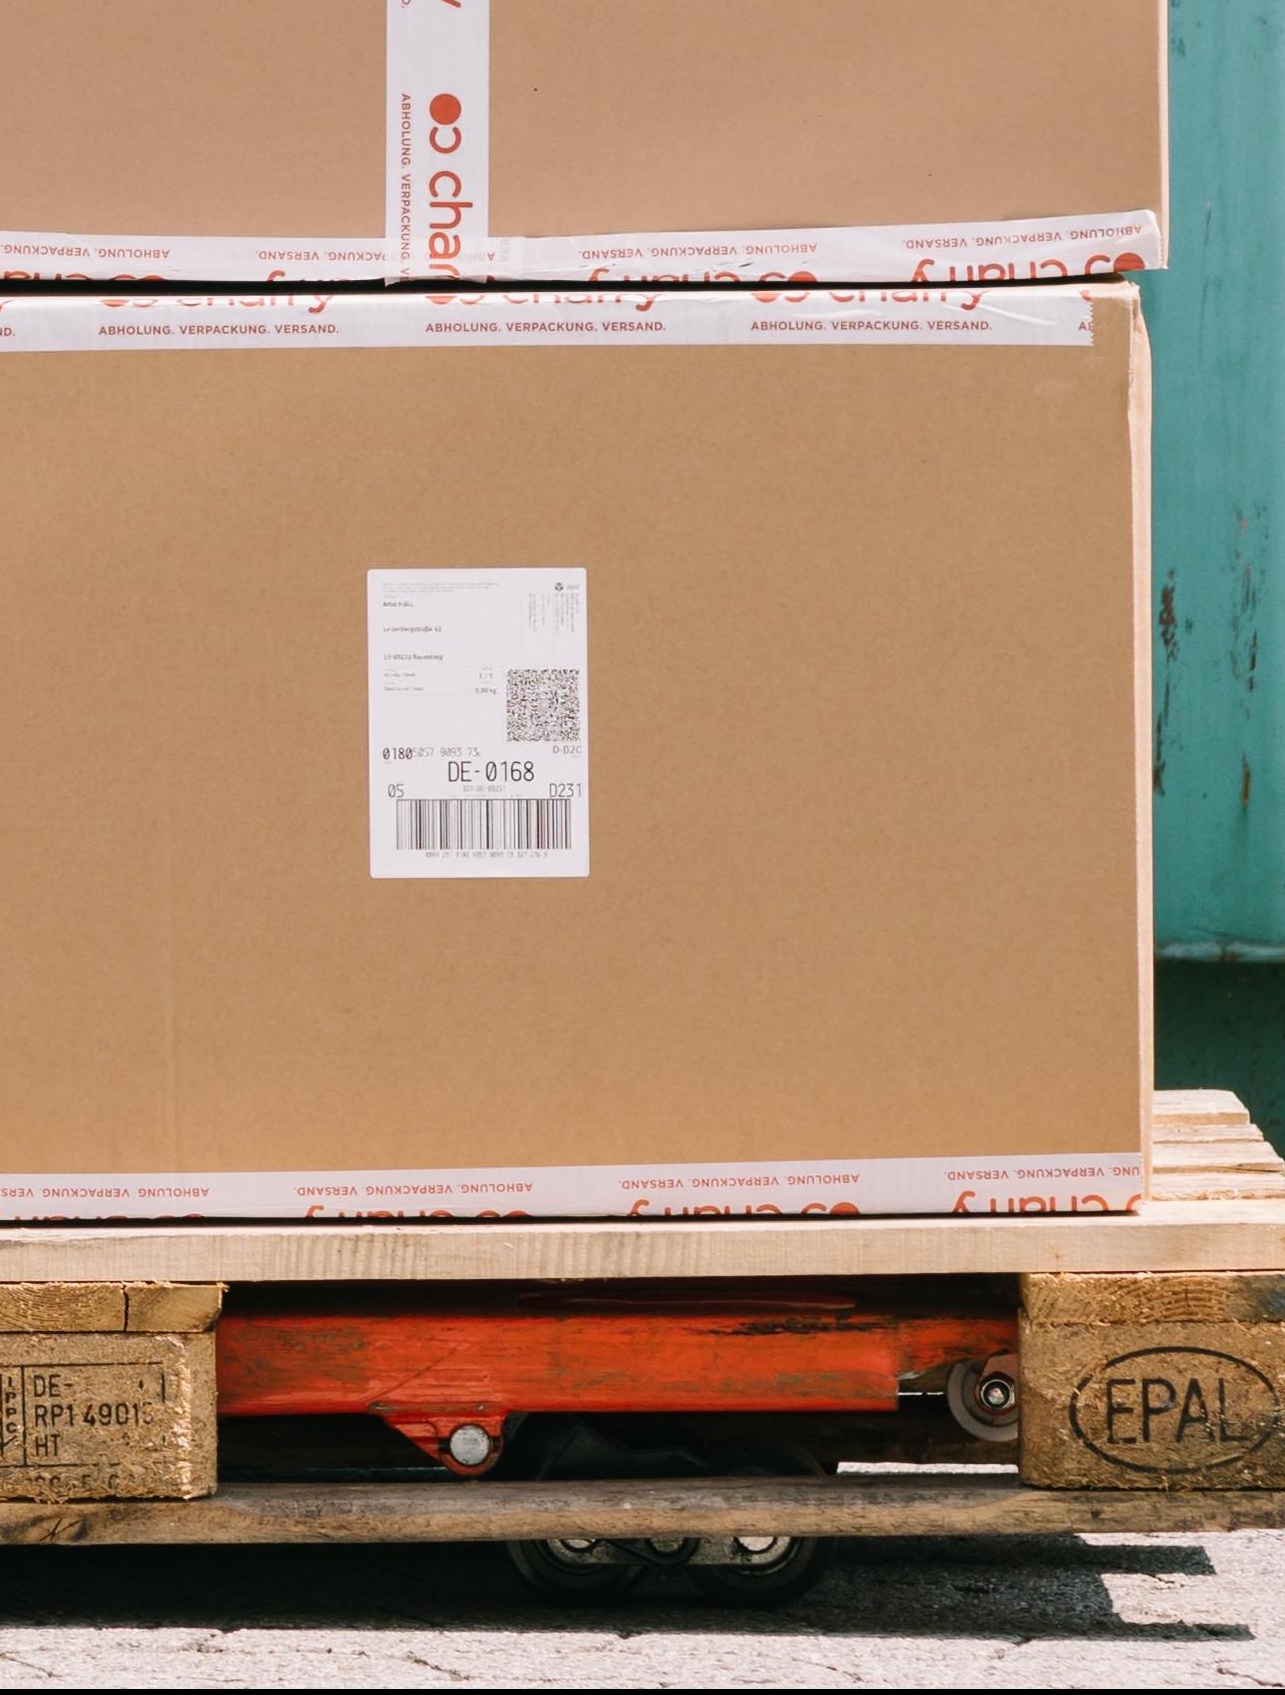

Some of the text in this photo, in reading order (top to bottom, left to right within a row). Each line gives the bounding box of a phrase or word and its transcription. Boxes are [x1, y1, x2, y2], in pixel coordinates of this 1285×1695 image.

[400, 93, 412, 263] ABHOLUNG. VERPACKUNG.
[902, 225, 1142, 249] ABHOLUNG. VERPACKUNG. VERSAND.
[0, 244, 90, 258] VERPACKUNG.
[94, 247, 170, 259] ABHOLUNG.
[255, 250, 319, 260] VERSAND.
[578, 243, 818, 259] ABHOLUNG. VERPACKUNG. VERSAND.
[98, 324, 340, 336] ABHOLUNG. VERPACKUNG. VERSAND.
[425, 321, 667, 333] ABHOLUNG. VERPACKUNG. VERSAND.
[751, 320, 993, 332] ABHOLUNG. VERPACKUNG. VERSAND.
[448, 761, 534, 782] DE-0168
[387, 783, 581, 798] 05 D231
[944, 1170, 1009, 1182] VERSAND.
[1014, 1166, 1105, 1180] VERPACKUNG.
[618, 1173, 860, 1190] ABHOLUNG. VERPACKUNG. VERSAND.
[293, 1182, 534, 1197] ABHOLUNG. VERPACKUNG. VERSAND.
[1105, 1377, 1254, 1444] EPAL
[35, 1435, 61, 1457] HT
